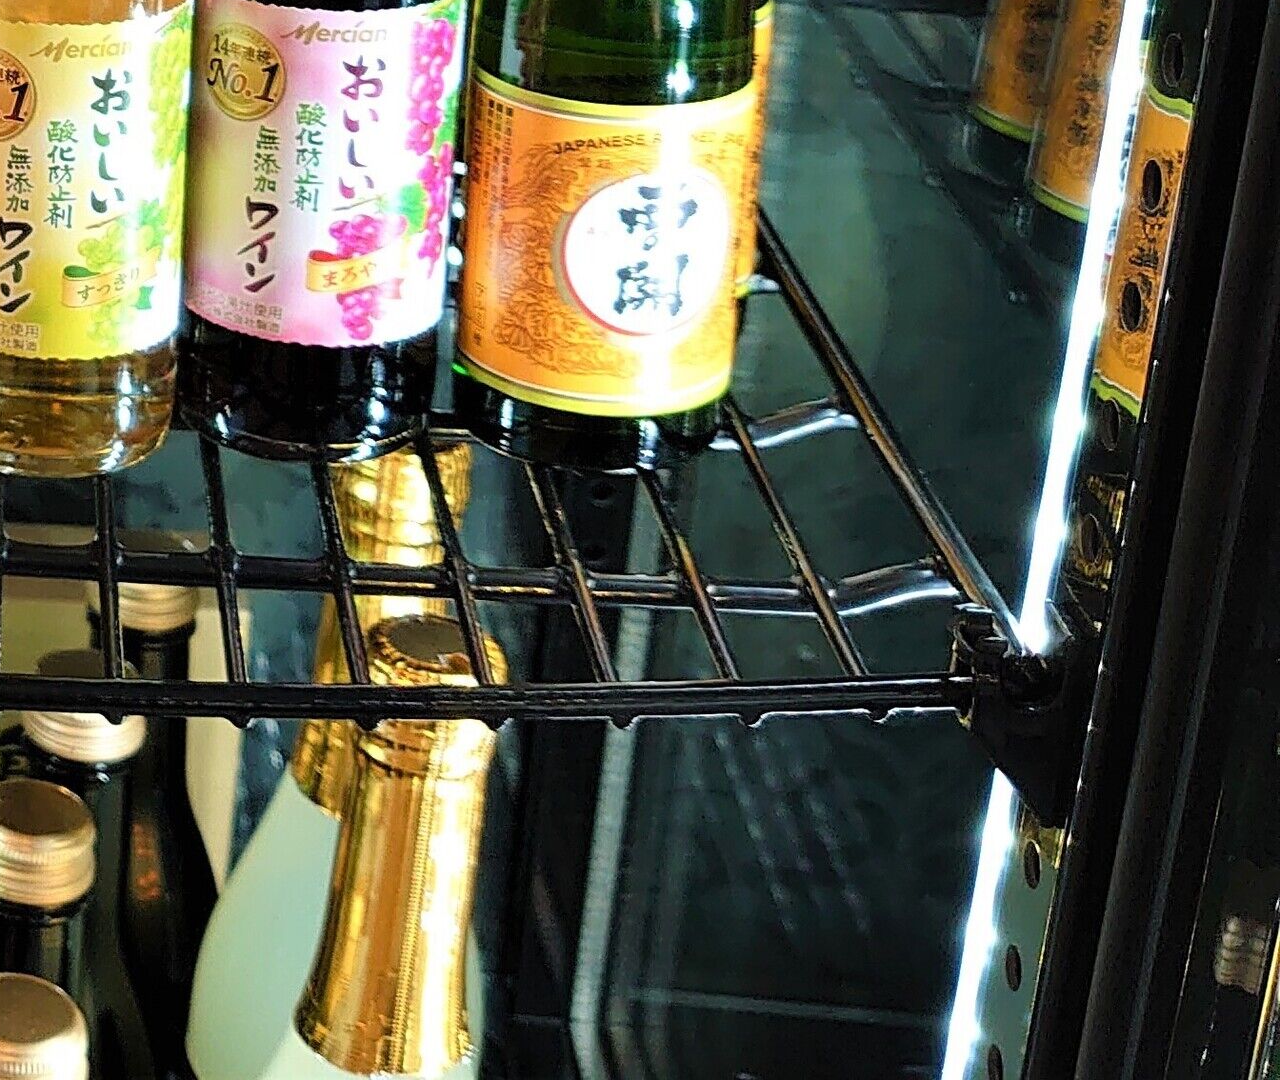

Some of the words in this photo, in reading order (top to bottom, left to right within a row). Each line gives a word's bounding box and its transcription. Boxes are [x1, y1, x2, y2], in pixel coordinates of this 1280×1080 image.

[42, 119, 80, 229] 酸化防止剤
[91, 67, 132, 214] おいしい
[252, 125, 282, 193] 無添加
[290, 103, 327, 213] 酸化防止剤
[339, 55, 387, 199] おいしい
[553, 133, 646, 155] JAPANESE
[4, 144, 35, 212] 無添加
[237, 195, 280, 294] ワイン
[322, 260, 378, 288] まろや
